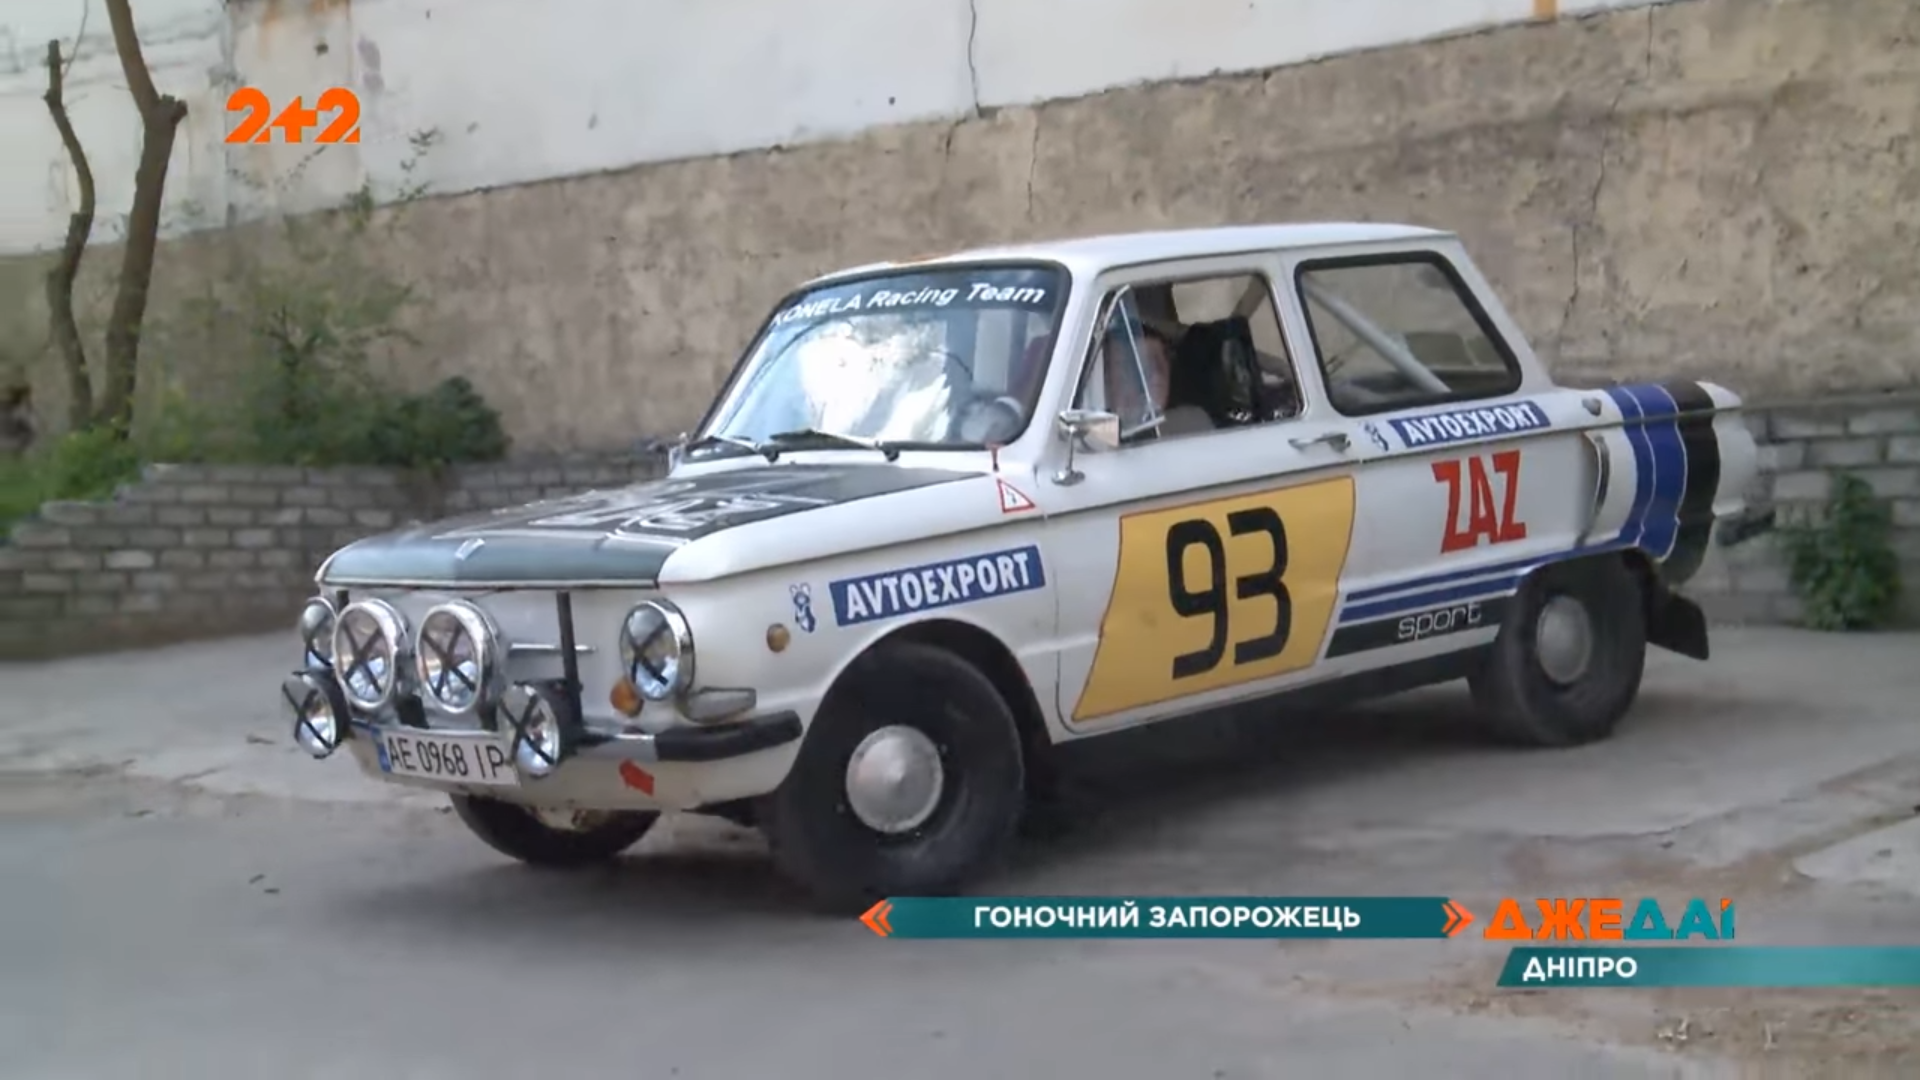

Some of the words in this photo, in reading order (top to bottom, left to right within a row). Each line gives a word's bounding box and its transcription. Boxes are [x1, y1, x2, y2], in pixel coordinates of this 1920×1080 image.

[867, 285, 958, 309] Racing
[966, 283, 1046, 304] Team
[1401, 403, 1540, 445] AVTOEXPORT
[1431, 450, 1527, 553] ZAZ
[847, 552, 1030, 619] AVTOEXPORT
[1166, 506, 1292, 679] 93
[1397, 603, 1482, 640] sport
[387, 737, 416, 770] AE
[416, 740, 468, 776] 0968
[474, 744, 505, 779] IP
